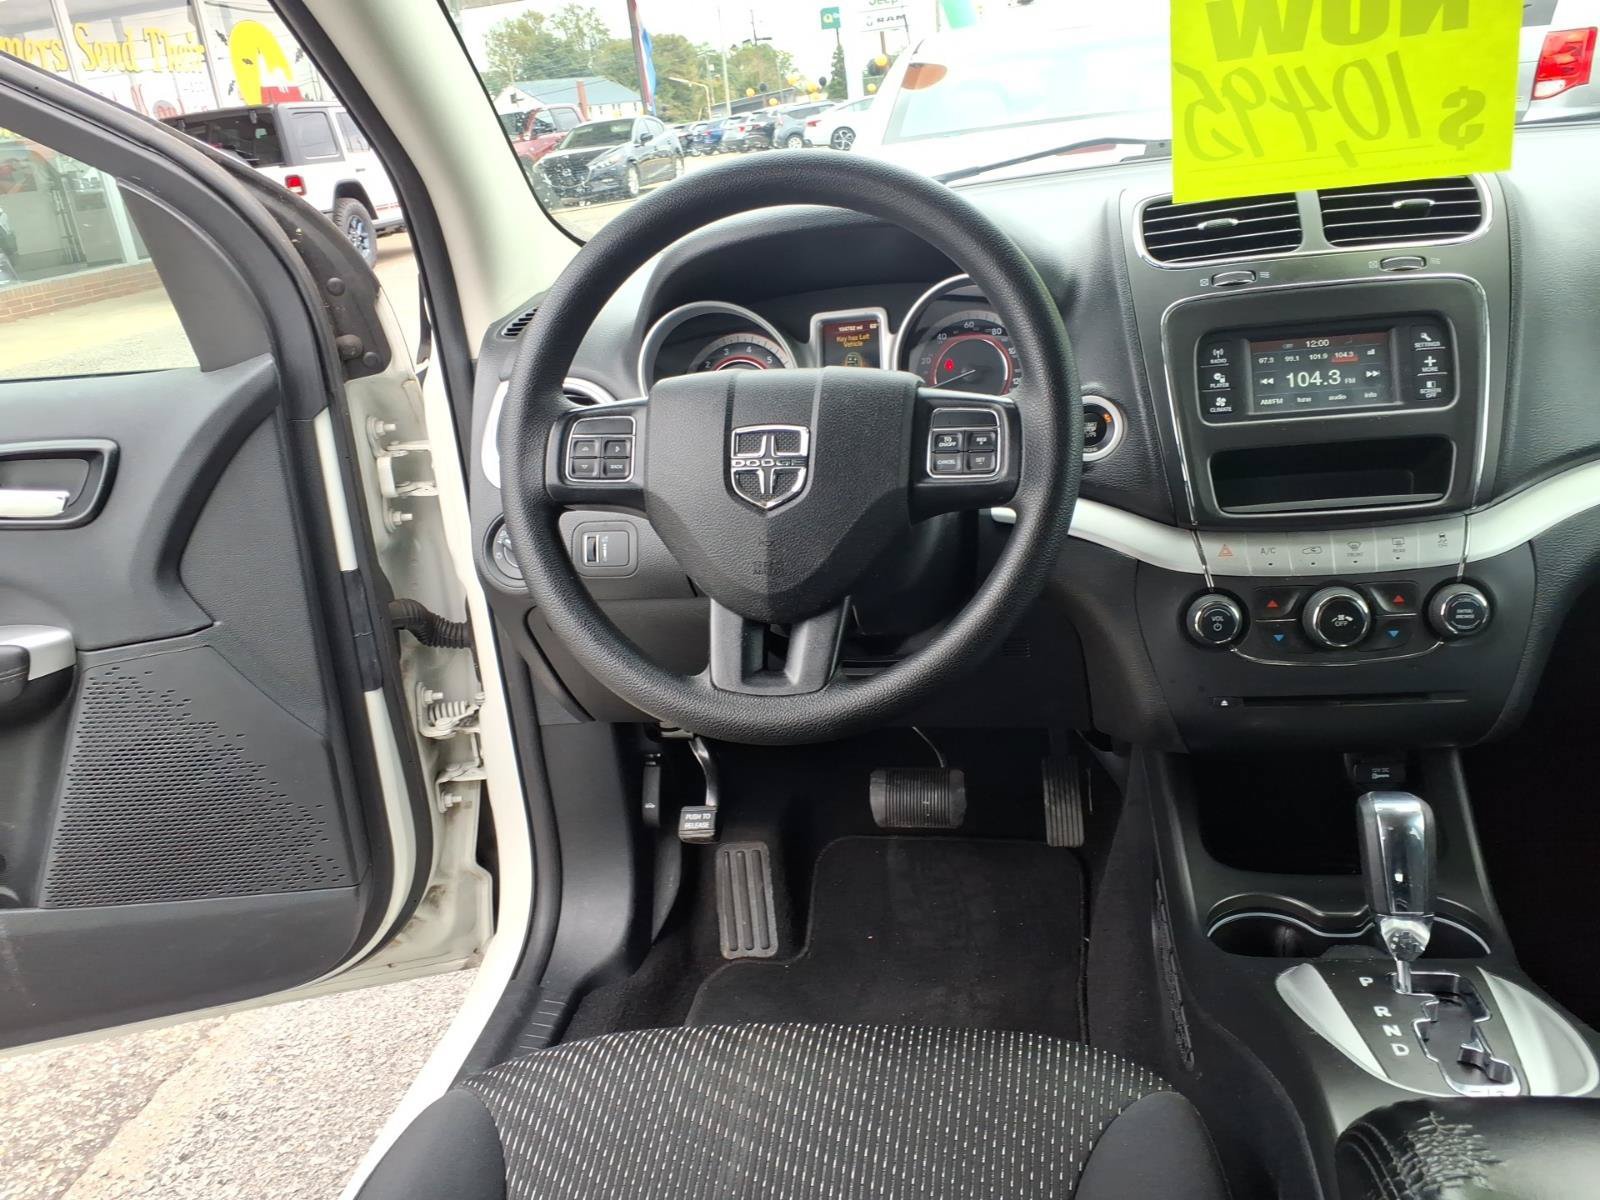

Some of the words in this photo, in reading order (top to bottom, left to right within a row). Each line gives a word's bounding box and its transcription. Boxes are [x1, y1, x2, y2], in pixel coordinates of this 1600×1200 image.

[73, 22, 143, 73] Send
[963, 321, 975, 329] 60
[991, 327, 1003, 336] 80
[1306, 339, 1330, 348] 12:00
[745, 345, 753, 353] 4
[766, 355, 773, 364] 5
[1285, 369, 1342, 388] 104.3
[732, 459, 805, 468] DODGE
[1260, 547, 1277, 555] A/C
[684, 813, 702, 821] PUSH
[702, 812, 712, 820] TO
[684, 821, 710, 829] RELEASE
[1358, 976, 1374, 987] P
[1373, 1006, 1392, 1018] R
[1382, 1025, 1402, 1037] N
[1391, 1044, 1410, 1056] D
